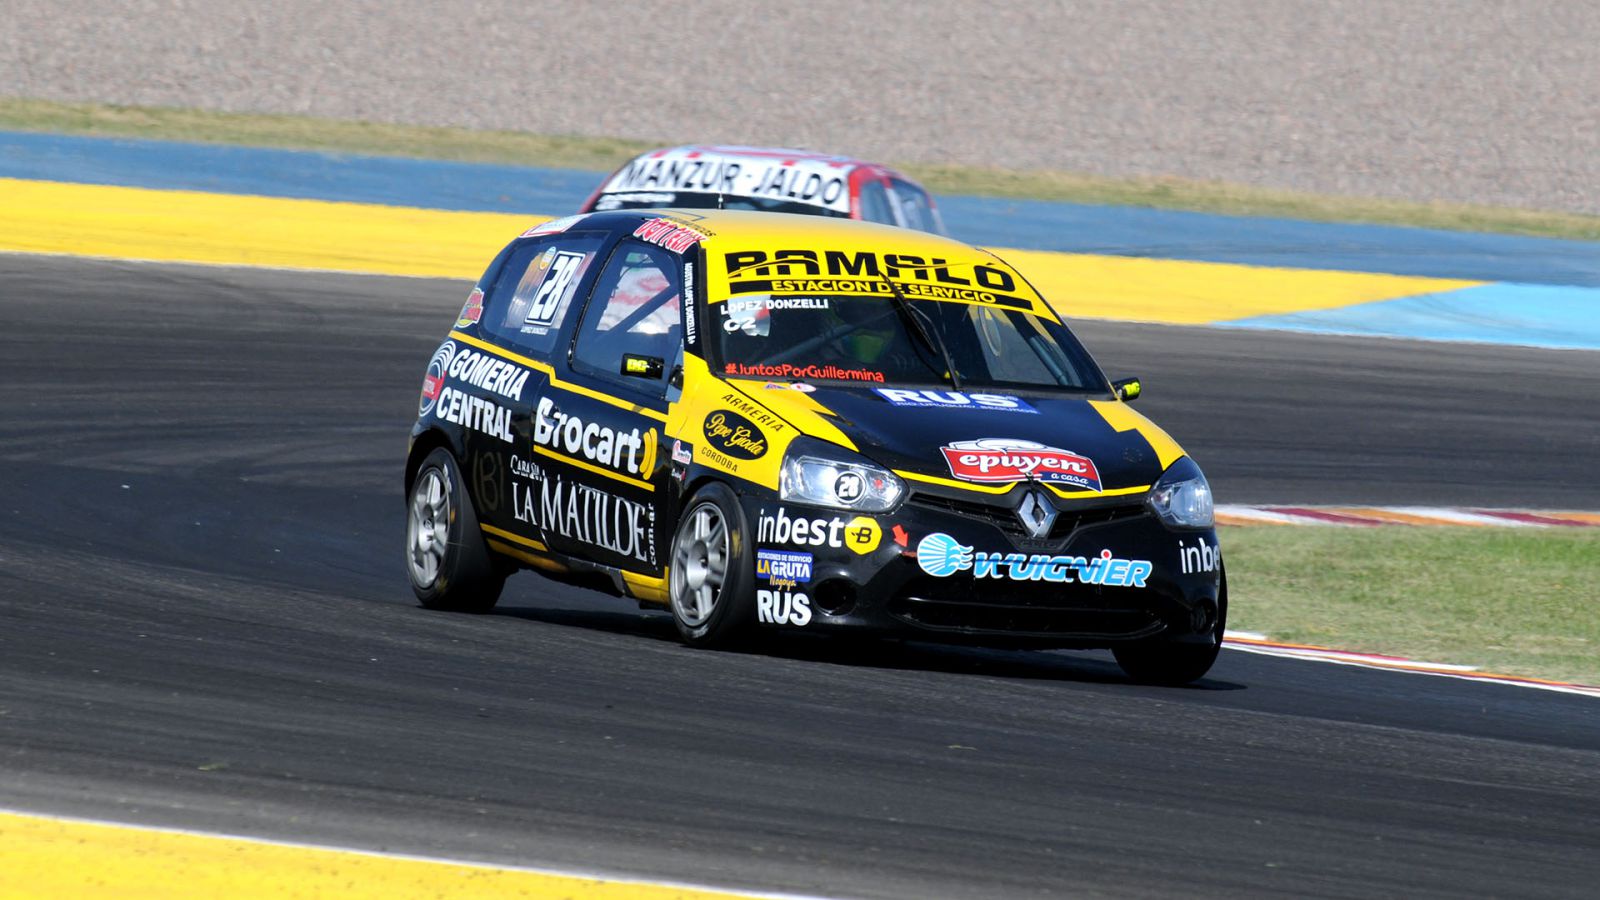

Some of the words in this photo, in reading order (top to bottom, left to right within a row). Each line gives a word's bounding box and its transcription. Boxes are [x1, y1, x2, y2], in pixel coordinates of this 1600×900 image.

[616, 160, 741, 193] MANZUR
[752, 166, 843, 205] JALDO
[528, 256, 582, 320] 28
[771, 280, 872, 294] ESTACION
[877, 282, 902, 296] DE
[907, 283, 996, 304] SERVICIO
[720, 301, 762, 316] LOPEZ
[766, 299, 829, 310] DONZELLI
[723, 316, 757, 332] C2
[448, 349, 531, 402] GOMERIA
[725, 362, 885, 383] #JuntosPorGuillermina
[877, 388, 1018, 408] RUS
[436, 386, 514, 443] CENTRAL
[706, 413, 733, 438] Pepe
[721, 394, 784, 432] ARMERIA
[533, 396, 641, 474] Brocart
[701, 446, 738, 472] CORDOBA
[959, 453, 1087, 473] epuyen
[838, 476, 860, 498] 28
[1061, 473, 1089, 485] casa
[512, 482, 538, 526] LA
[541, 469, 648, 562] MATILDE
[757, 507, 844, 548] inbest
[757, 559, 770, 574] LA
[770, 560, 810, 578] GRUTA
[757, 589, 812, 626] RUS
